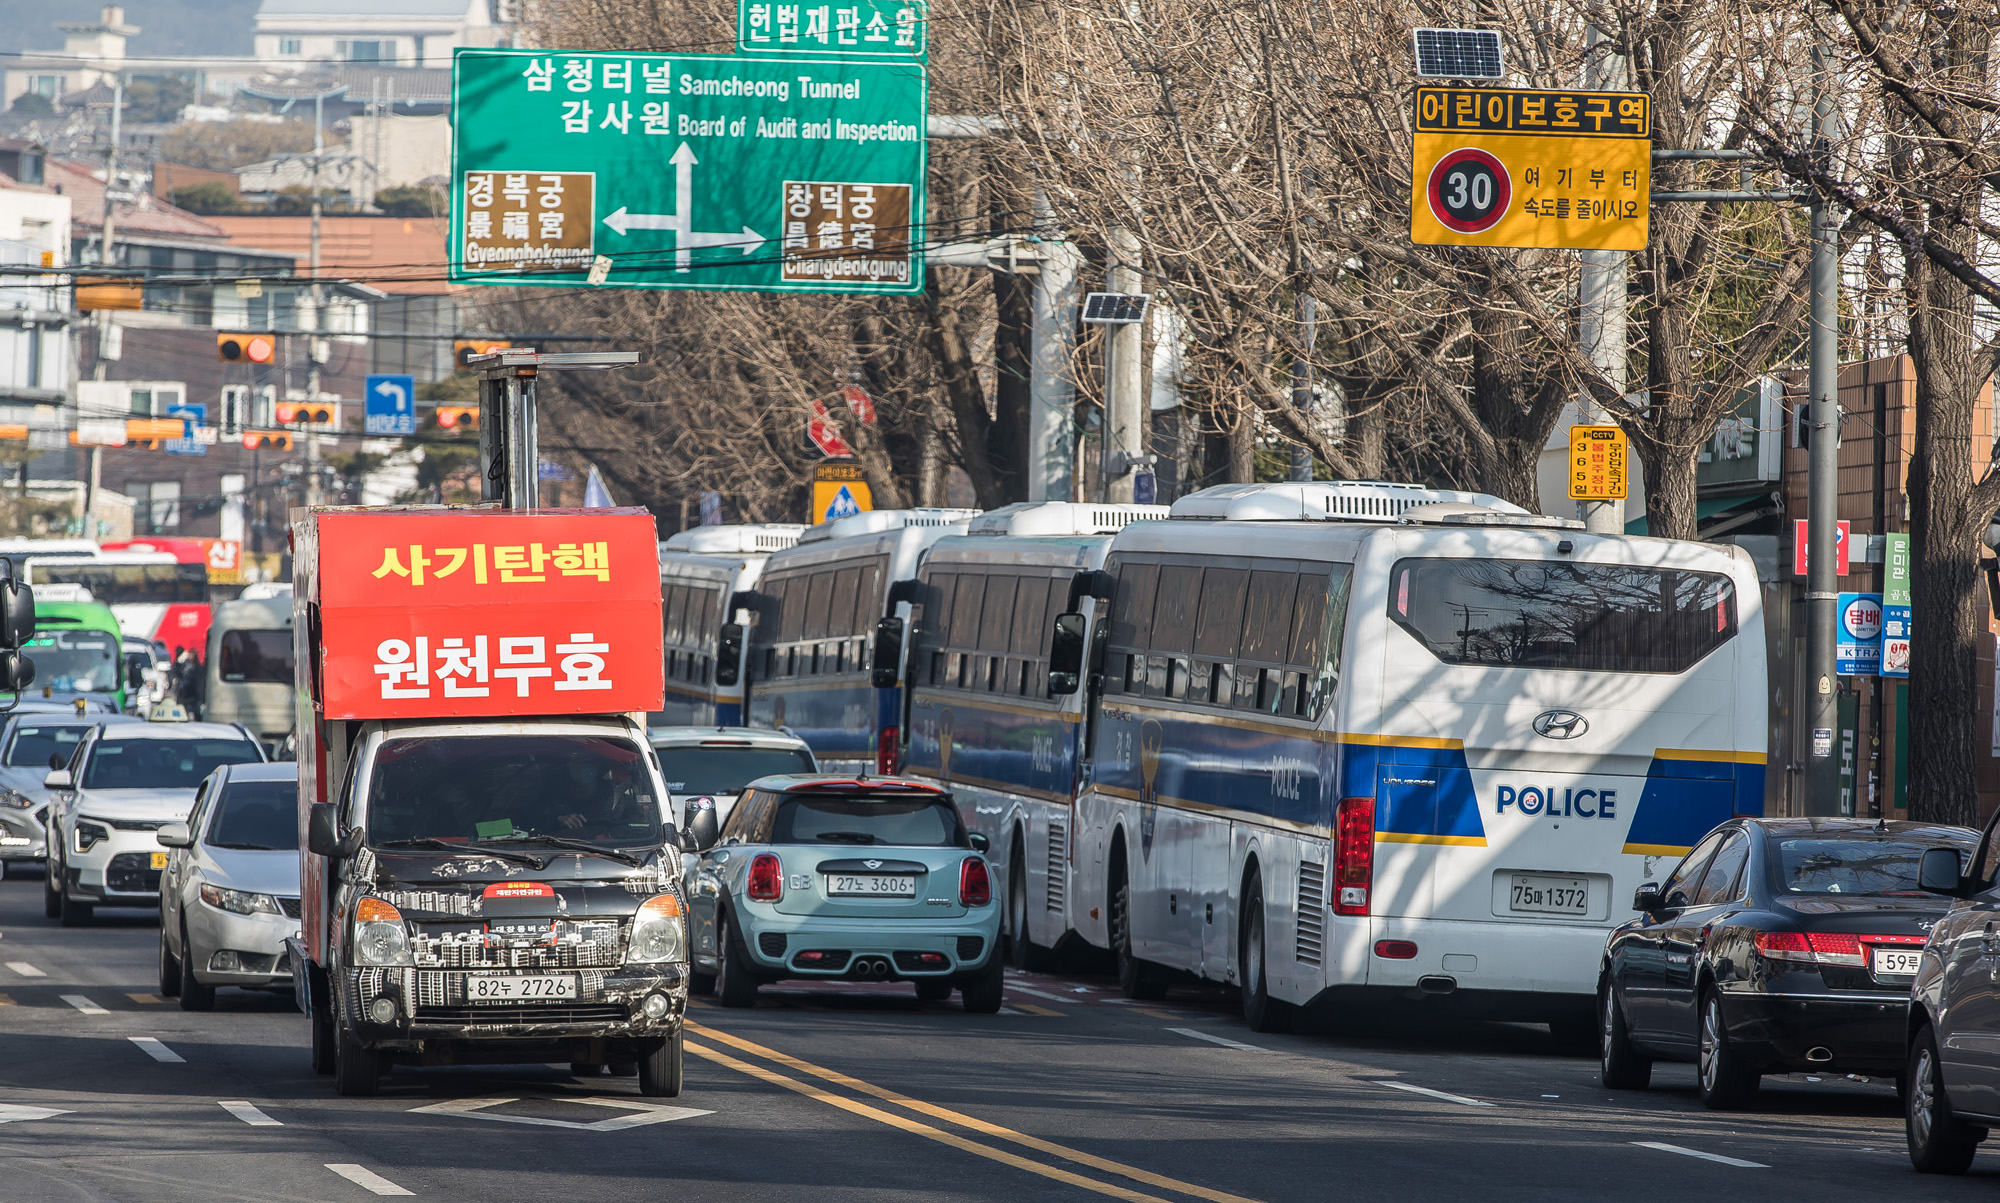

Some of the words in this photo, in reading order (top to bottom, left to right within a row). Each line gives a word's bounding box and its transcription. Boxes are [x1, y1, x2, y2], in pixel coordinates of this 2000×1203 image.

[748, 3, 918, 47] 헌법재판소앞
[522, 57, 672, 95] 삼청터널
[679, 73, 790, 103] Samcheong
[797, 76, 860, 100] Tunnel
[560, 99, 671, 136] 감사원
[678, 113, 726, 138] Board
[729, 115, 747, 138] of
[755, 117, 798, 139] Audit
[801, 119, 832, 141] and
[835, 119, 918, 144] Inspection
[1422, 92, 1644, 133] 어린이보호구역
[467, 173, 565, 209] 경복궁
[786, 183, 877, 219] 창덕궁
[1447, 171, 1493, 210] 30
[467, 211, 565, 240] 景福宮
[1523, 196, 1572, 220] 속도를
[1575, 198, 1640, 221] 줄이시오
[466, 241, 591, 269] Gyeongbokgung
[785, 252, 908, 281] Changdeokgung
[1574, 442, 1587, 495] 365일
[1591, 443, 1604, 495] 불법주정차
[372, 541, 610, 586] 사기탄핵
[1849, 609, 1880, 625] 담배
[374, 633, 612, 699] 원천무효
[1845, 649, 1880, 657] KTRA
[1271, 754, 1301, 800] POLICE
[1497, 785, 1616, 819] POLICE
[836, 877, 864, 891] 27노
[871, 878, 907, 891] 3606
[1886, 954, 1918, 970] 59루
[477, 980, 511, 996] 82누
[521, 979, 565, 995] 2726
